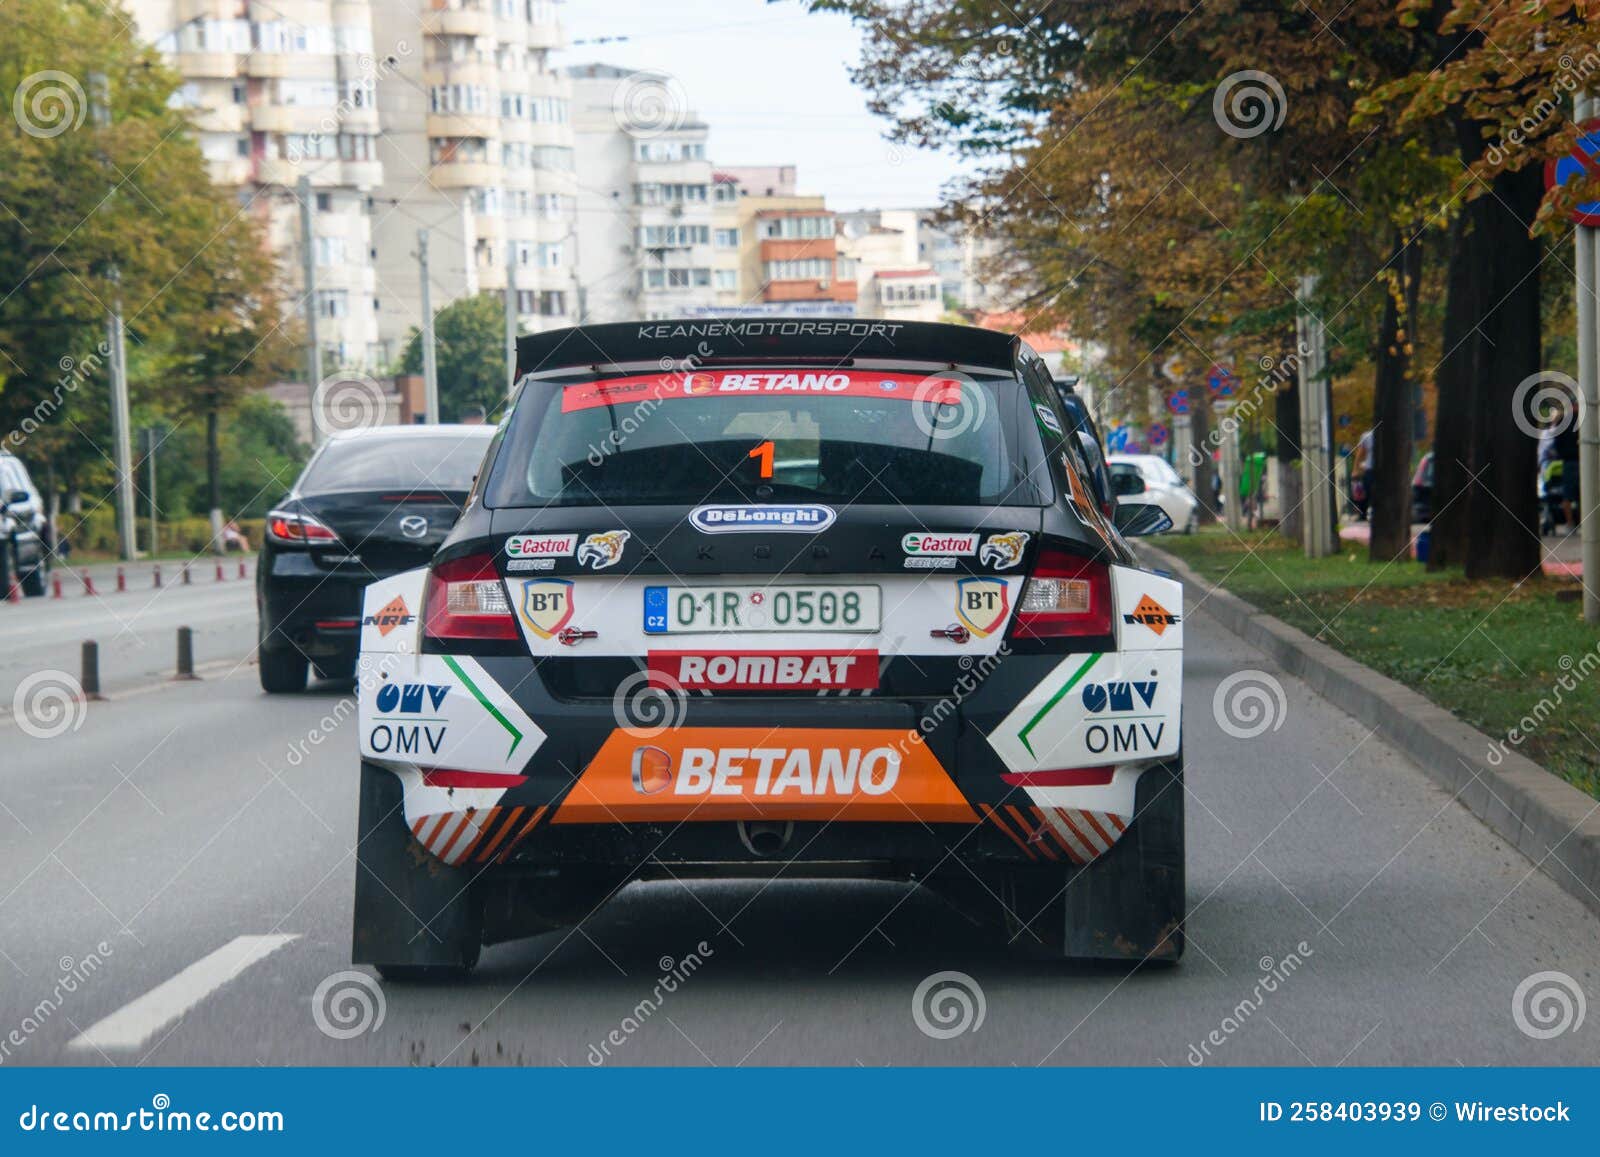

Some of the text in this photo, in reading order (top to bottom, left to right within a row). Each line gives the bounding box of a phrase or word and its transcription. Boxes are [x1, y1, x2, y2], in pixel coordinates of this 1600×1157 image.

[638, 322, 903, 339] KEANEMOTORSPORT
[719, 374, 850, 392] BETANO
[749, 441, 774, 478] 1
[522, 539, 570, 554] Castrol
[922, 537, 972, 552] Castrol
[531, 592, 564, 612] BT
[677, 591, 861, 626] 01R 0508
[966, 591, 998, 610] BT
[362, 615, 416, 626] NRF
[647, 616, 665, 627] CZ
[1123, 614, 1181, 625] NRF
[370, 724, 447, 754] OMV
[1085, 722, 1165, 753] OMV
[674, 747, 901, 796] BETANO
